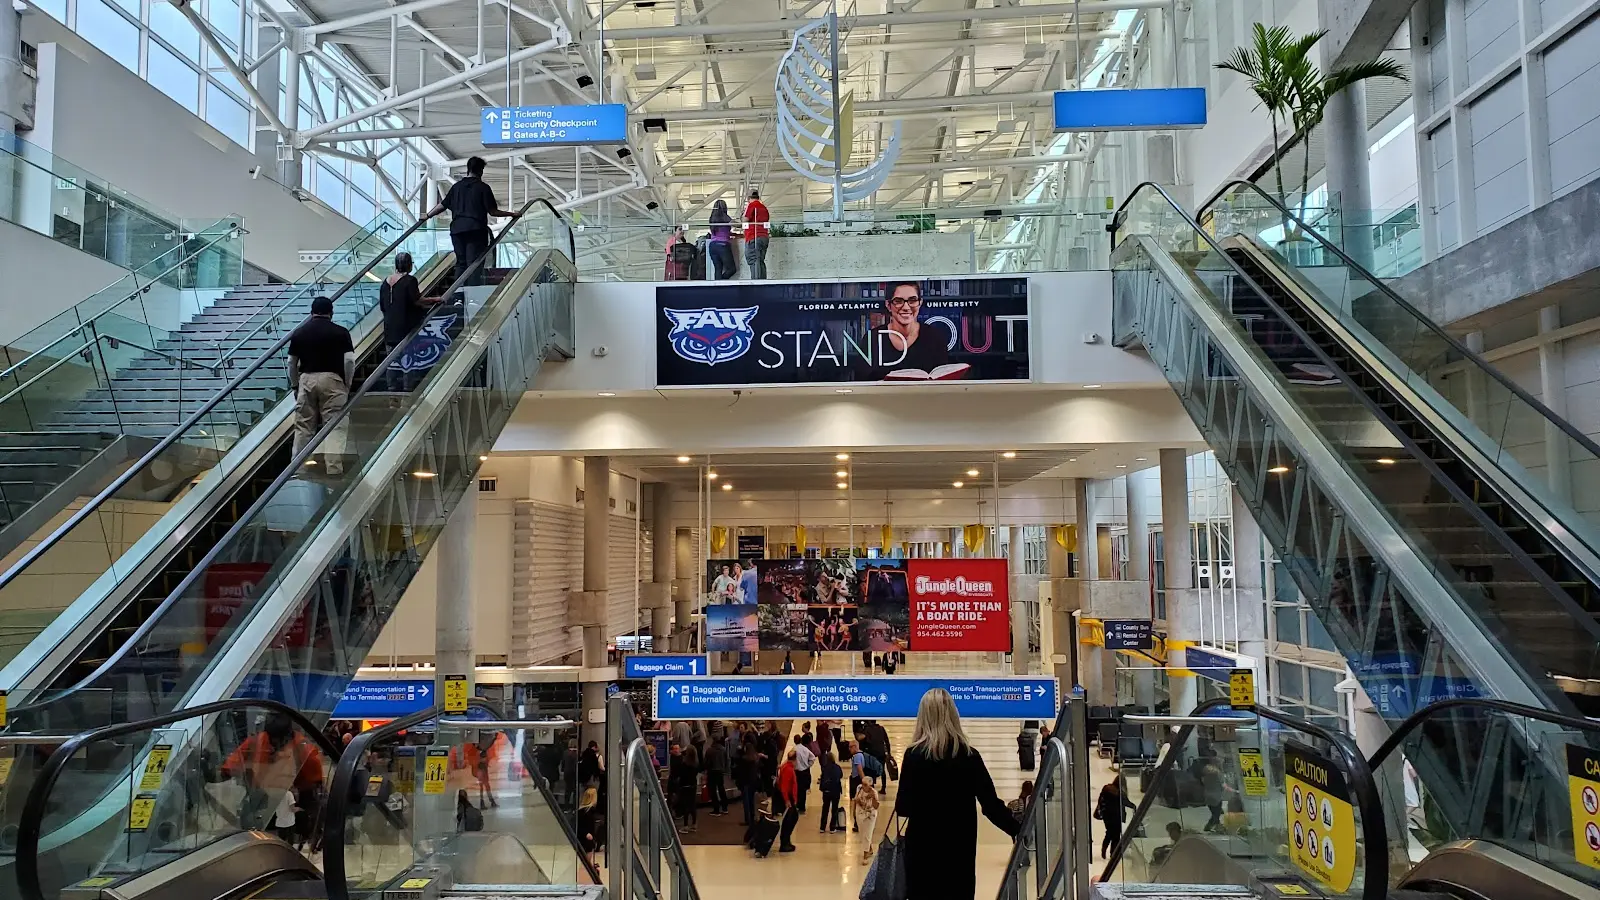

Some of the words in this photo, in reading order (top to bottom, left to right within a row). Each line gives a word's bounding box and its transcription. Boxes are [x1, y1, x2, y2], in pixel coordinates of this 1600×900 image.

[513, 110, 552, 119] Ticketing
[513, 120, 548, 129] Security
[549, 119, 598, 128] Checkpoint
[513, 131, 538, 139] Gates
[540, 130, 566, 138] A-B-C
[675, 310, 746, 333] FAU
[757, 329, 908, 369] STAND
[916, 601, 937, 611] IT'S
[940, 601, 971, 611] MORE
[973, 601, 1002, 611] THAN
[916, 612, 924, 621] A
[927, 612, 954, 621] BOAT
[958, 612, 987, 621] RIDE.
[634, 663, 664, 672] Baggage
[665, 663, 684, 671] Claim
[688, 658, 697, 675] 1
[692, 686, 727, 694] Baggage
[728, 685, 750, 693] Claim
[810, 685, 837, 693] Rental
[839, 685, 859, 693] Cars
[975, 685, 1022, 693] Transportation
[810, 695, 844, 703] Cypress
[846, 695, 877, 703] Garage
[810, 703, 840, 712] County
[842, 703, 859, 711] Bus
[1294, 757, 1328, 787] CAUTION
